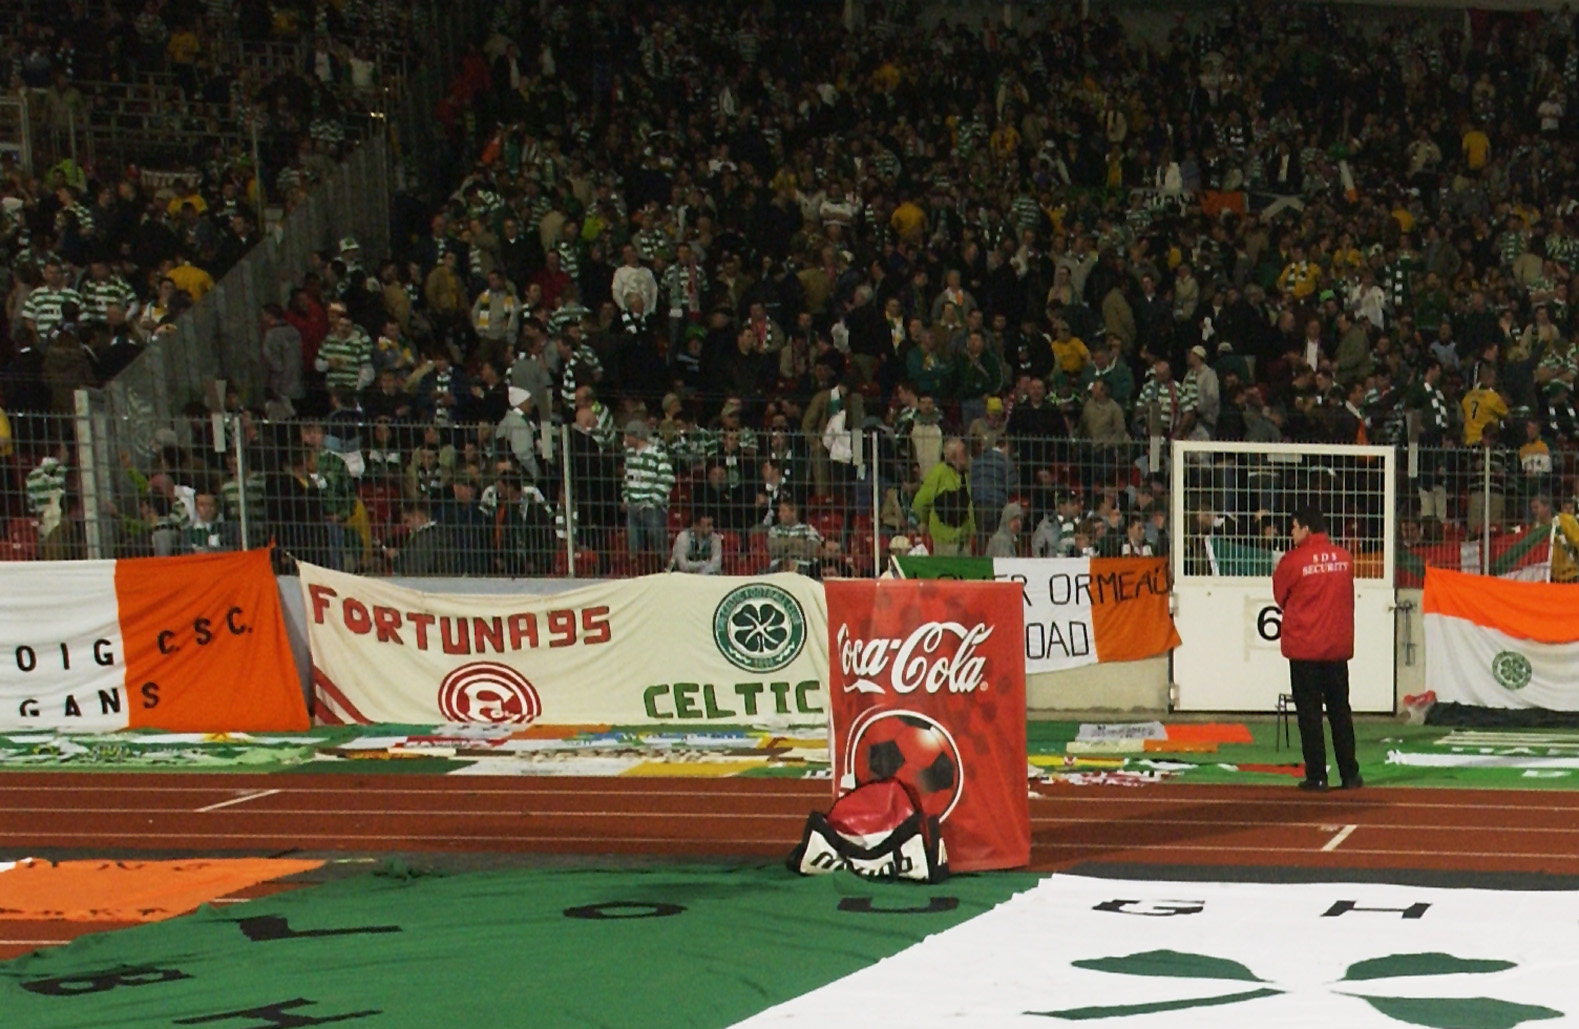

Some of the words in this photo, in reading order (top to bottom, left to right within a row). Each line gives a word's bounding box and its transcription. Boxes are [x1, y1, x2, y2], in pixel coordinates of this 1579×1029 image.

[1302, 562, 1349, 577] SECURITY
[1025, 621, 1090, 660] OAD
[1257, 605, 1283, 642] 6
[837, 621, 995, 694] Coca-Cola
[643, 680, 825, 719] CELTIC
